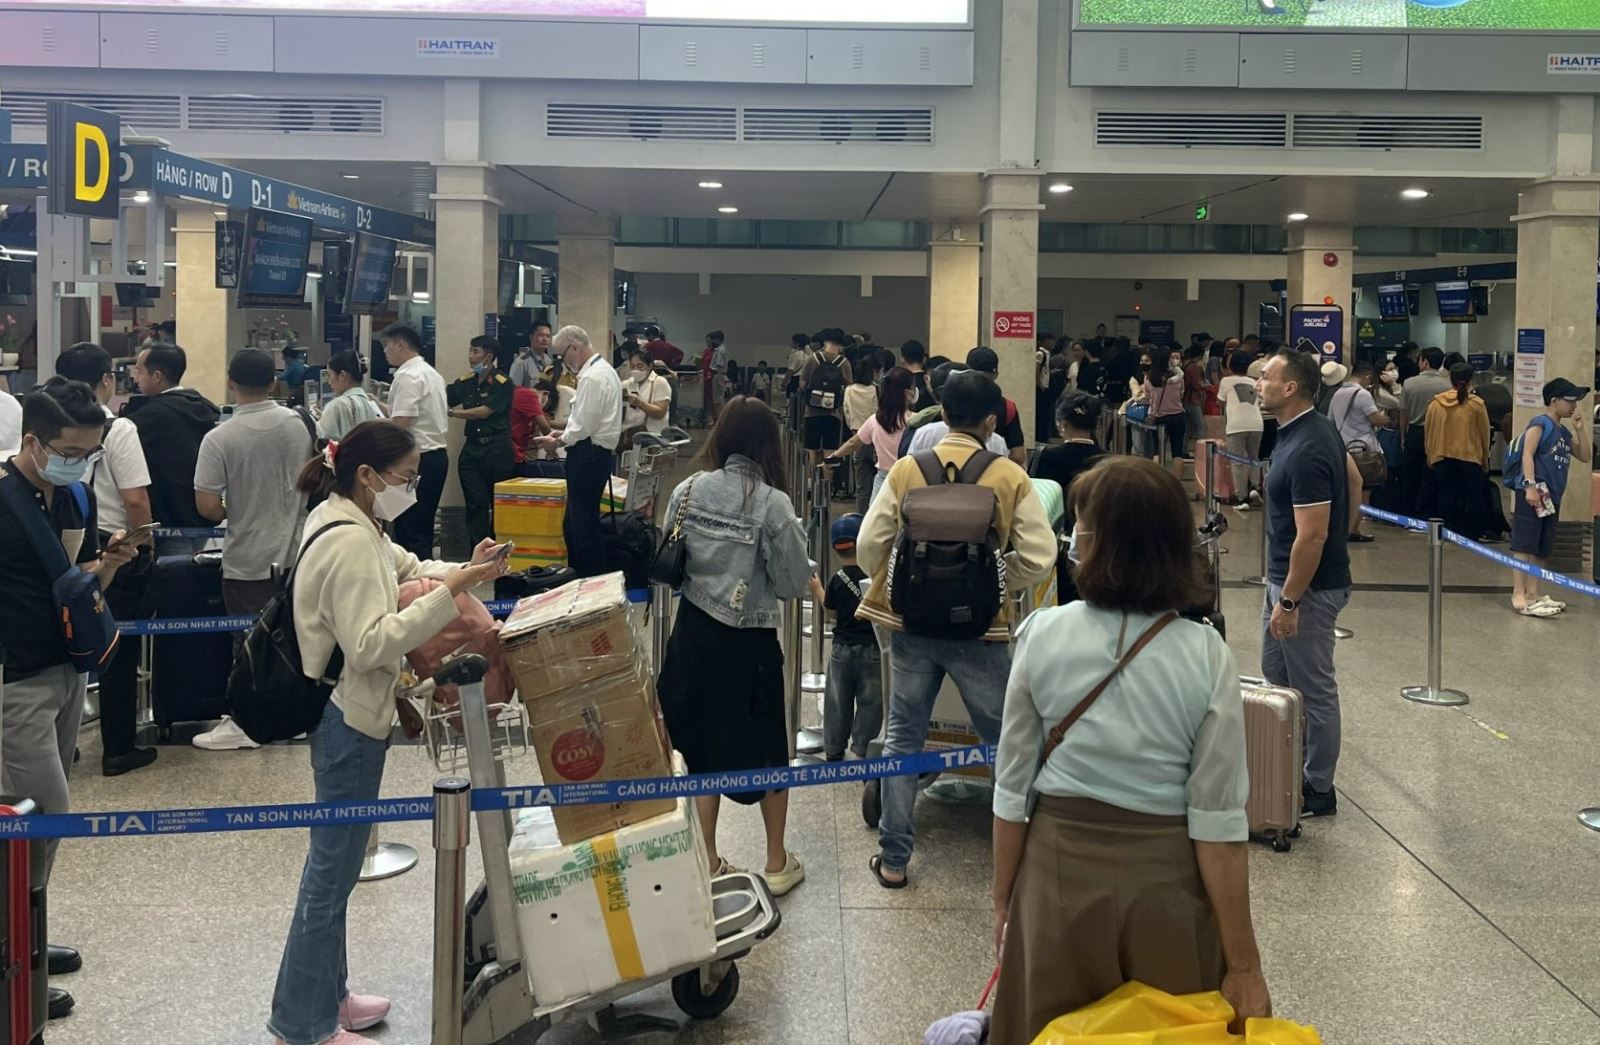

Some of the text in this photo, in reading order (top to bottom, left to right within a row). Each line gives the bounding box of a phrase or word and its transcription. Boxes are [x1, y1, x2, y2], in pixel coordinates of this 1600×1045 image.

[428, 40, 494, 50] HAITRAN
[75, 121, 110, 202] D
[156, 159, 233, 200] HÀNG / ROW D
[251, 179, 272, 208] D-1
[356, 206, 372, 230] D-2
[156, 528, 182, 537] TIA
[1540, 568, 1554, 581] TIA
[939, 748, 985, 768] TIA
[617, 781, 656, 796] CẢNG
[660, 779, 698, 793] HÀNG
[701, 775, 748, 790] KHÔNG
[792, 768, 808, 781] TẾ
[839, 765, 866, 777] SƠN
[501, 788, 557, 807] TIA
[83, 815, 147, 833] TIA
[226, 813, 254, 824] TAN
[258, 810, 289, 822] SON
[292, 808, 331, 820] NHAT
